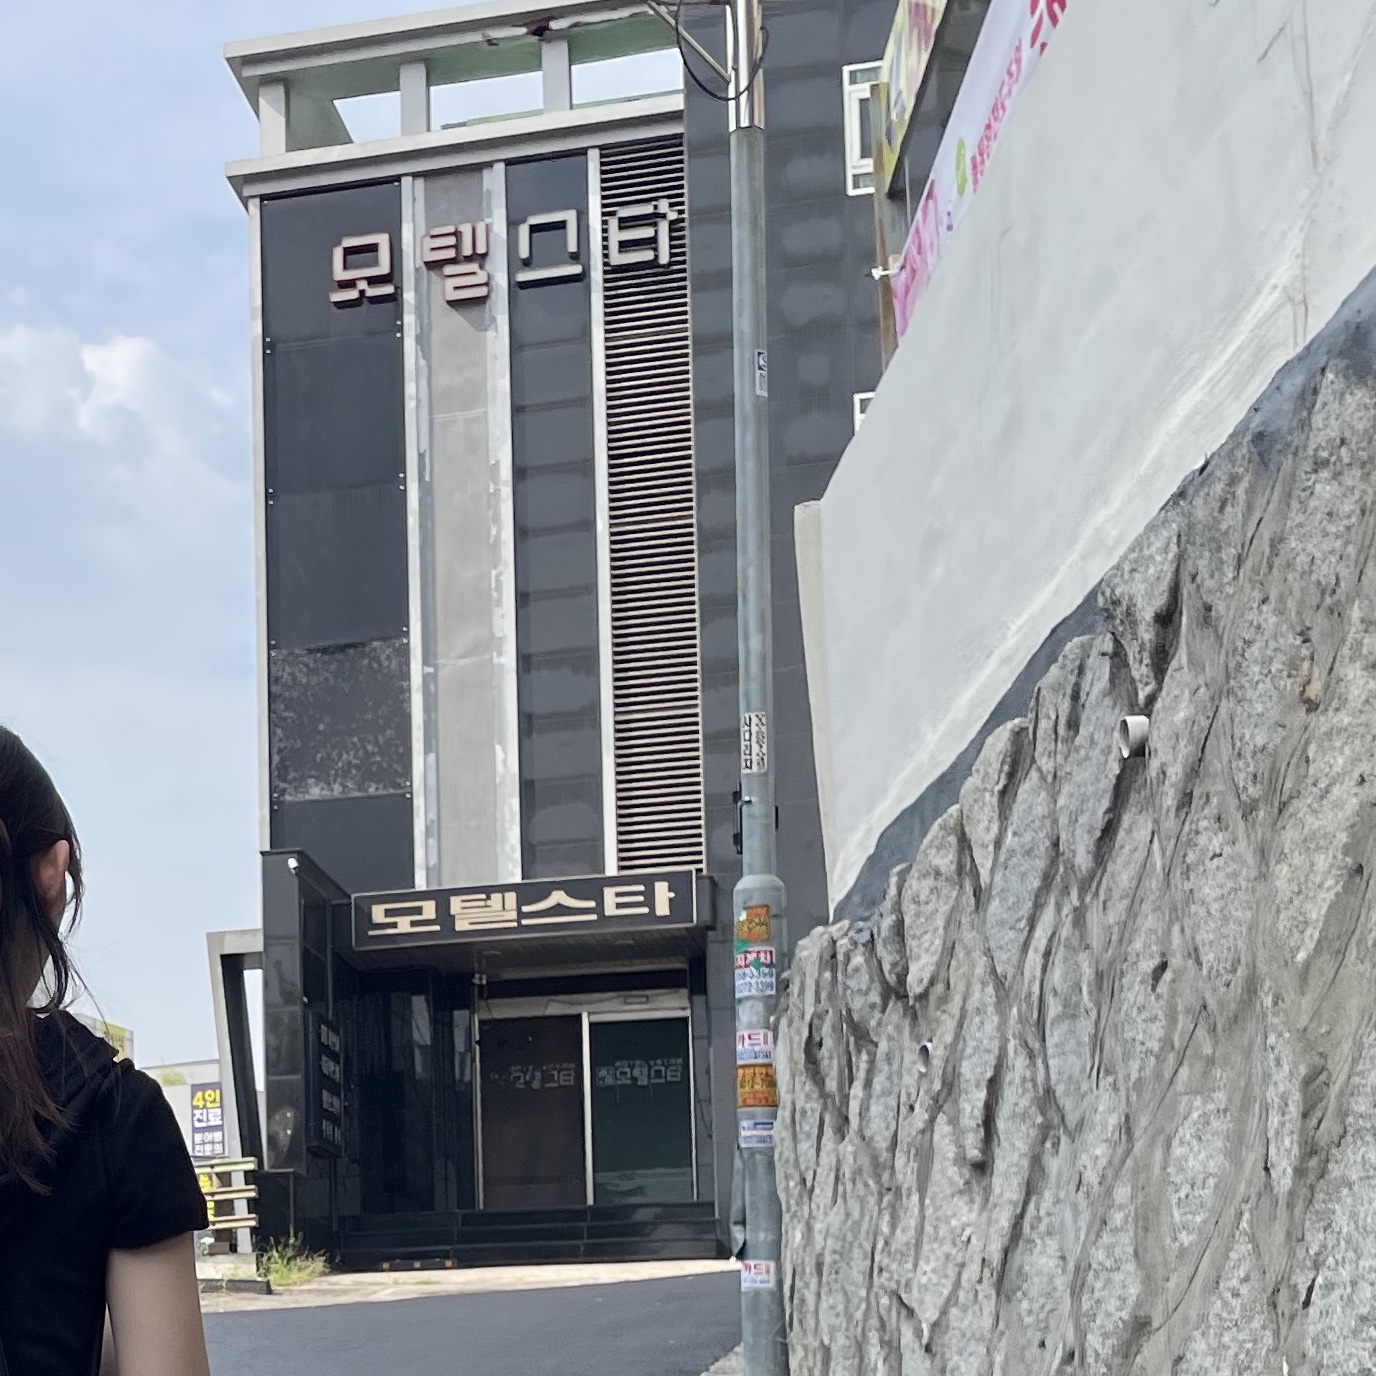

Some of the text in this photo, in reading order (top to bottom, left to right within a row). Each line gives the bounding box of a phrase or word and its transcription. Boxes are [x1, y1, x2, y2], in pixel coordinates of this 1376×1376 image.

[328, 199, 679, 306] 모텔스타
[368, 881, 675, 933] 모텔스타
[192, 1089, 221, 1109] 4인
[192, 1108, 223, 1128] 진료
